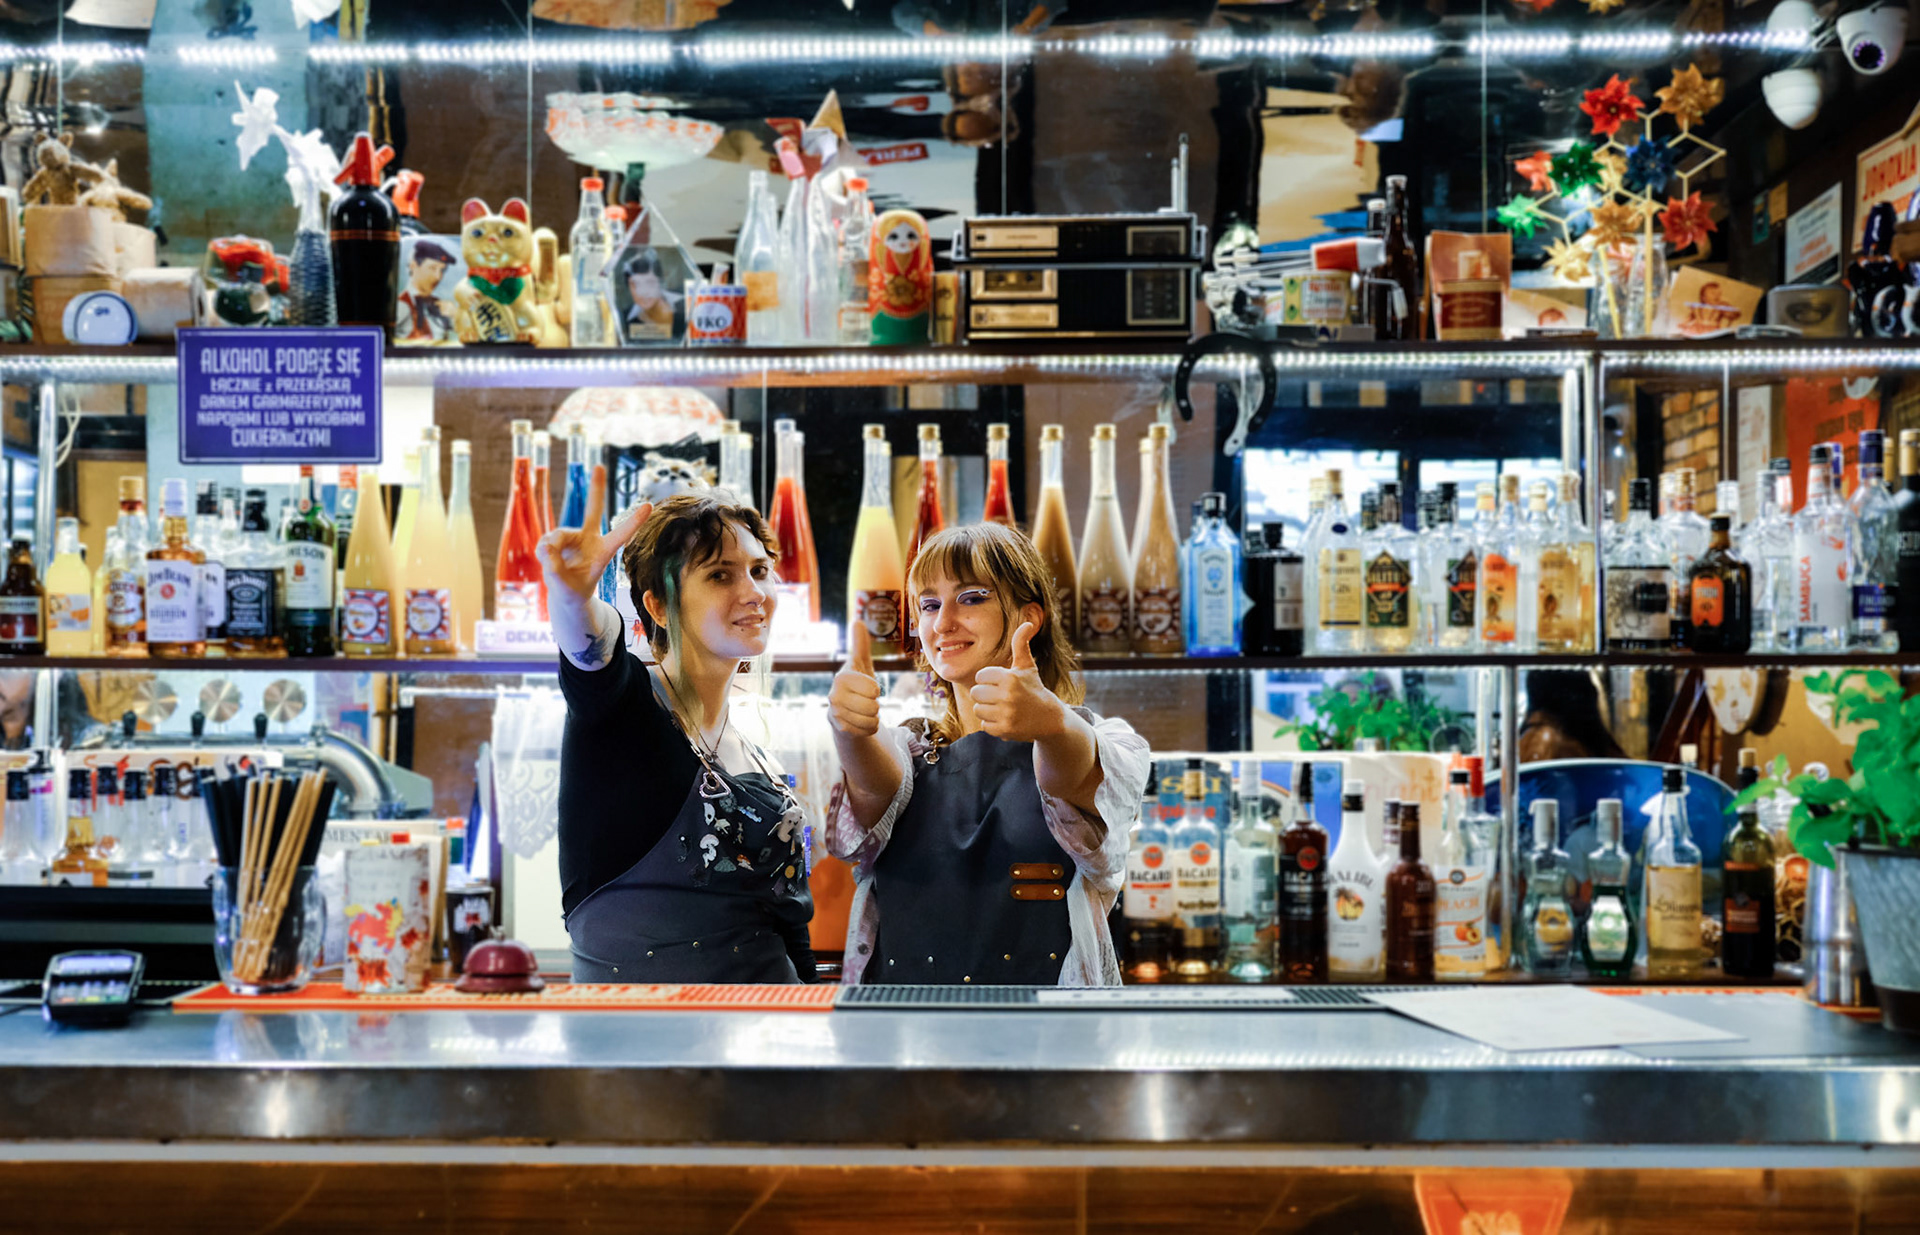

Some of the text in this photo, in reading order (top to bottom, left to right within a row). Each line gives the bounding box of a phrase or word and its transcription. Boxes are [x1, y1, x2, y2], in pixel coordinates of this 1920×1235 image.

[200, 347, 271, 374] ALKOHOL
[336, 347, 362, 378] SIĘ
[200, 395, 249, 409] DANIEM
[197, 411, 366, 427] NAPOJAMI LUB WYROBAMI
[1799, 555, 1811, 623] SAMBUCA
